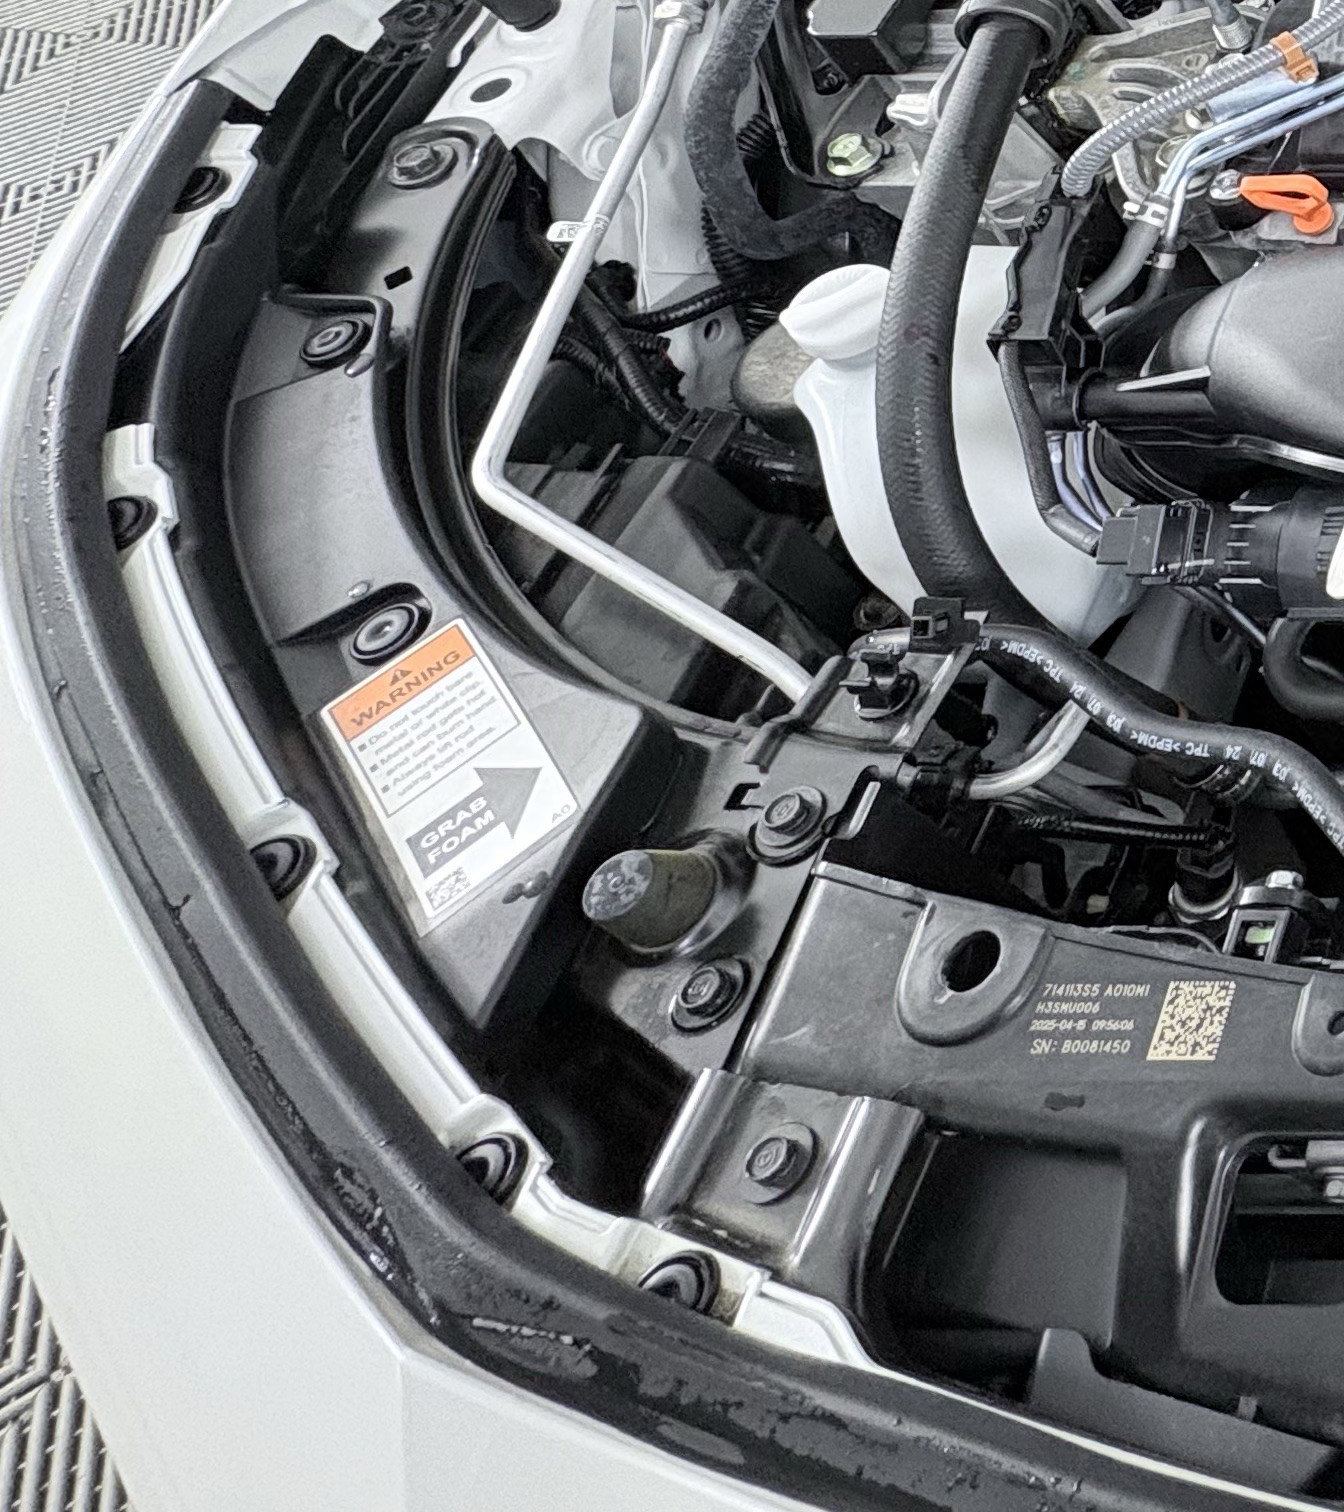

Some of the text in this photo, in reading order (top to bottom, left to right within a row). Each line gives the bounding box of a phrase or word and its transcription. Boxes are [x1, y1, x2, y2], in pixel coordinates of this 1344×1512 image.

[350, 650, 461, 727] WARNING
[1184, 742, 1210, 758] TPC
[420, 796, 488, 849] GRAB
[426, 810, 495, 864] FOAM
[1030, 1038, 1058, 1055] SN:
